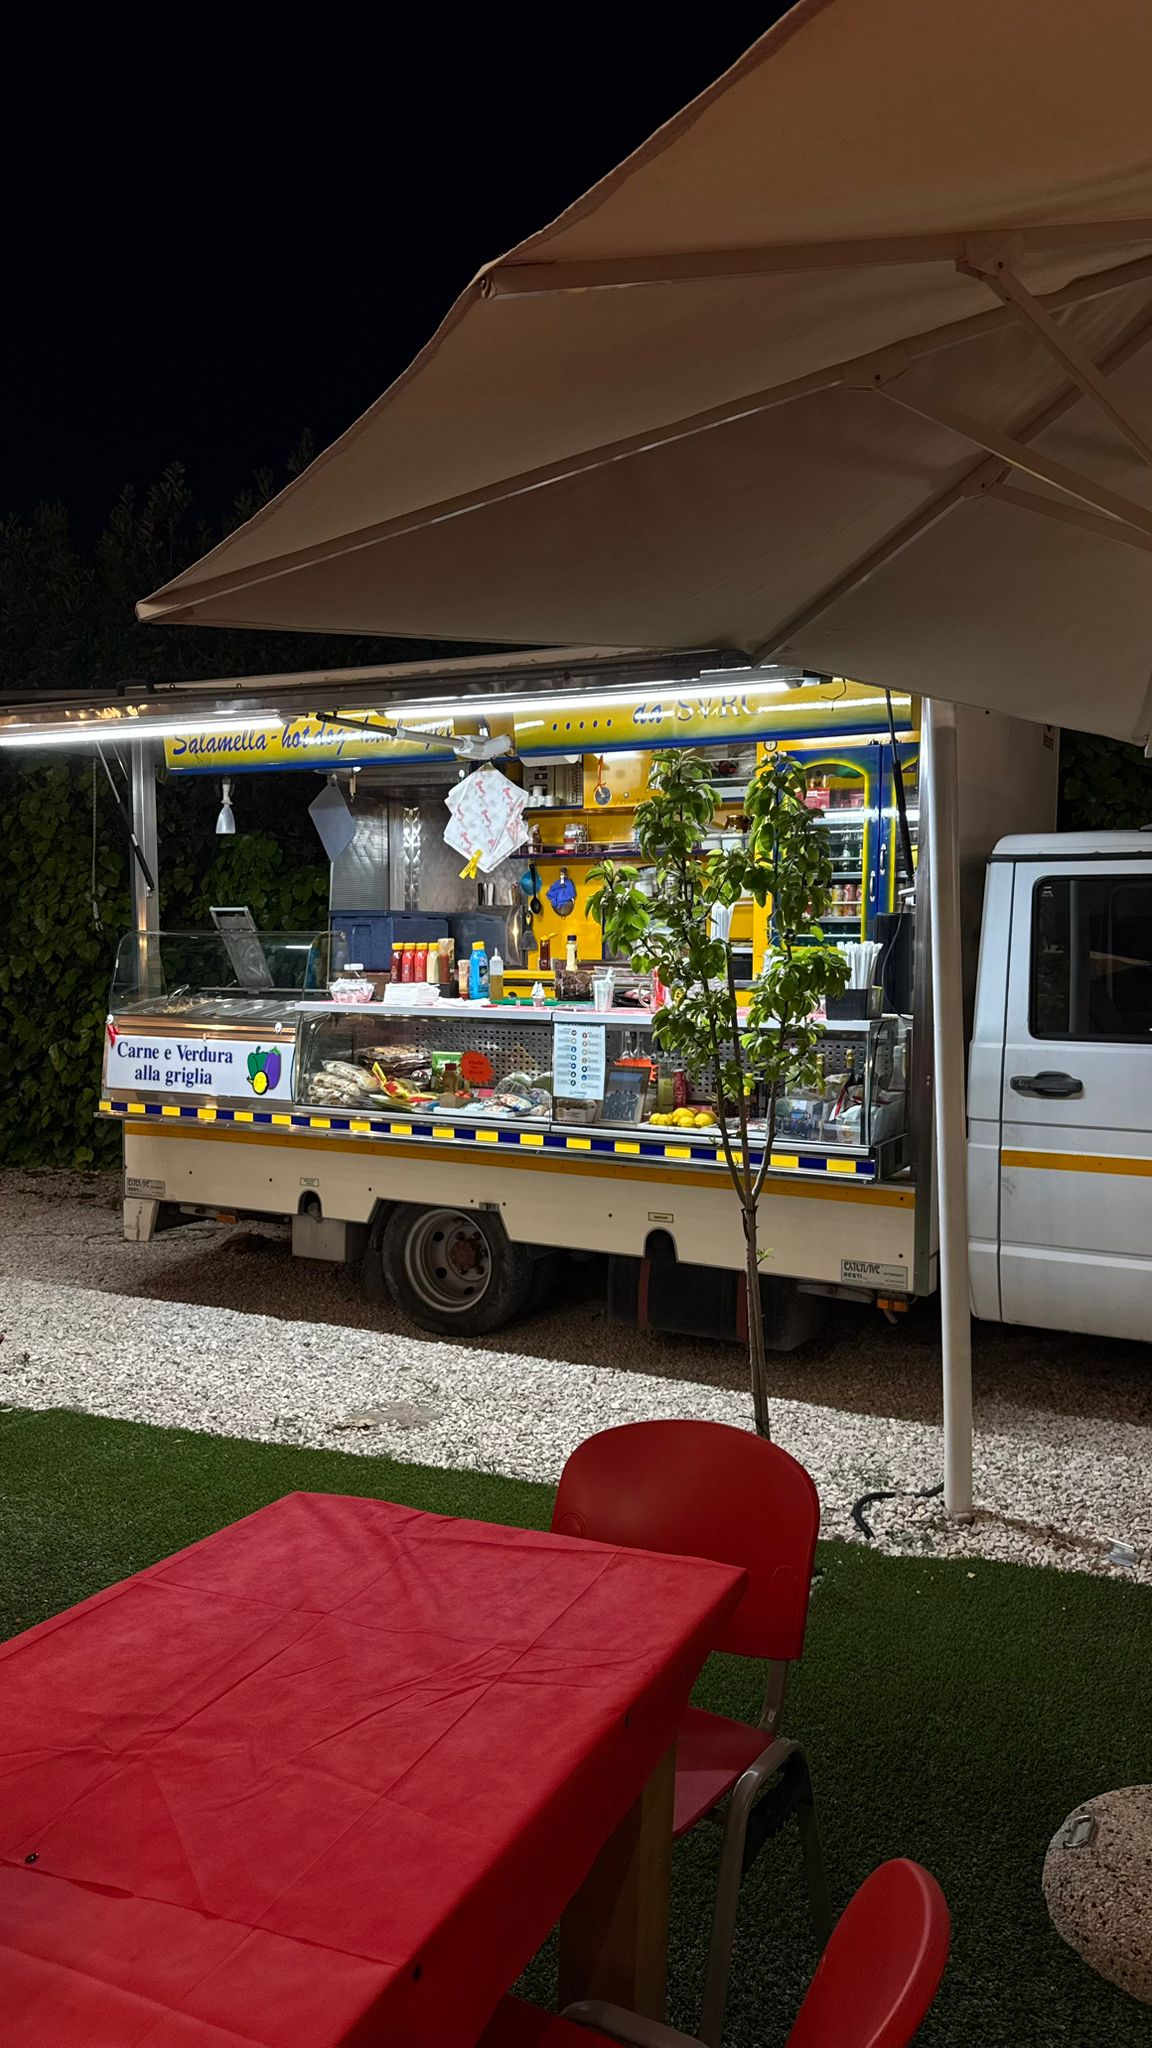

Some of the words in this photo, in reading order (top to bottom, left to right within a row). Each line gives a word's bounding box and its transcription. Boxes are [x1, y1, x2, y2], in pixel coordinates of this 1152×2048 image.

[117, 1041, 159, 1060] Carne
[164, 1047, 172, 1060] e
[177, 1045, 233, 1064] Verdura
[135, 1065, 160, 1081] alla
[165, 1067, 213, 1088] griglia
